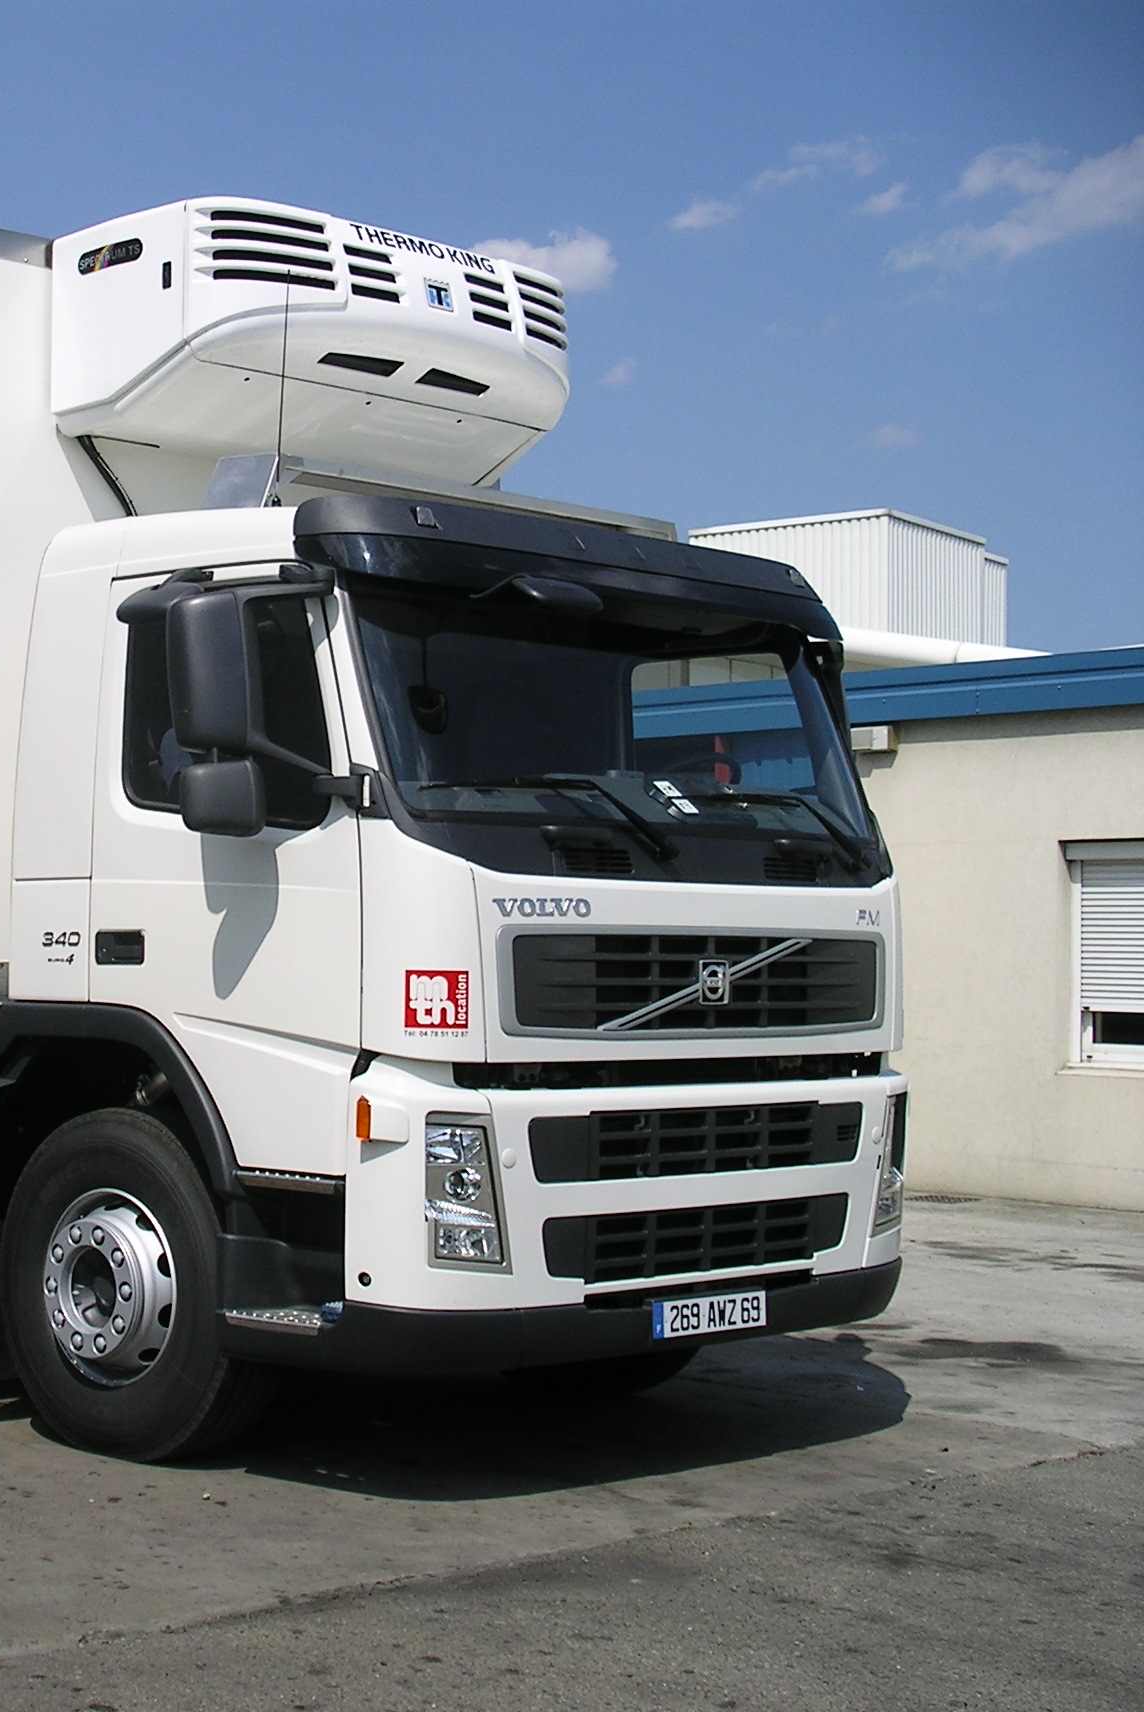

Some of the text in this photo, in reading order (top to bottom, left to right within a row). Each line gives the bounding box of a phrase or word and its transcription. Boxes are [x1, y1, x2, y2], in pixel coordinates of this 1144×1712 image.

[79, 243, 141, 271] SPECRUM TS
[350, 223, 496, 274] THERMO KING
[492, 897, 592, 918] VOLVO
[856, 909, 880, 927] FM
[42, 931, 81, 947] 340
[455, 974, 467, 1025] location
[670, 1303, 701, 1333] 269
[707, 1299, 737, 1329] AWZ
[740, 1296, 761, 1324] 69
